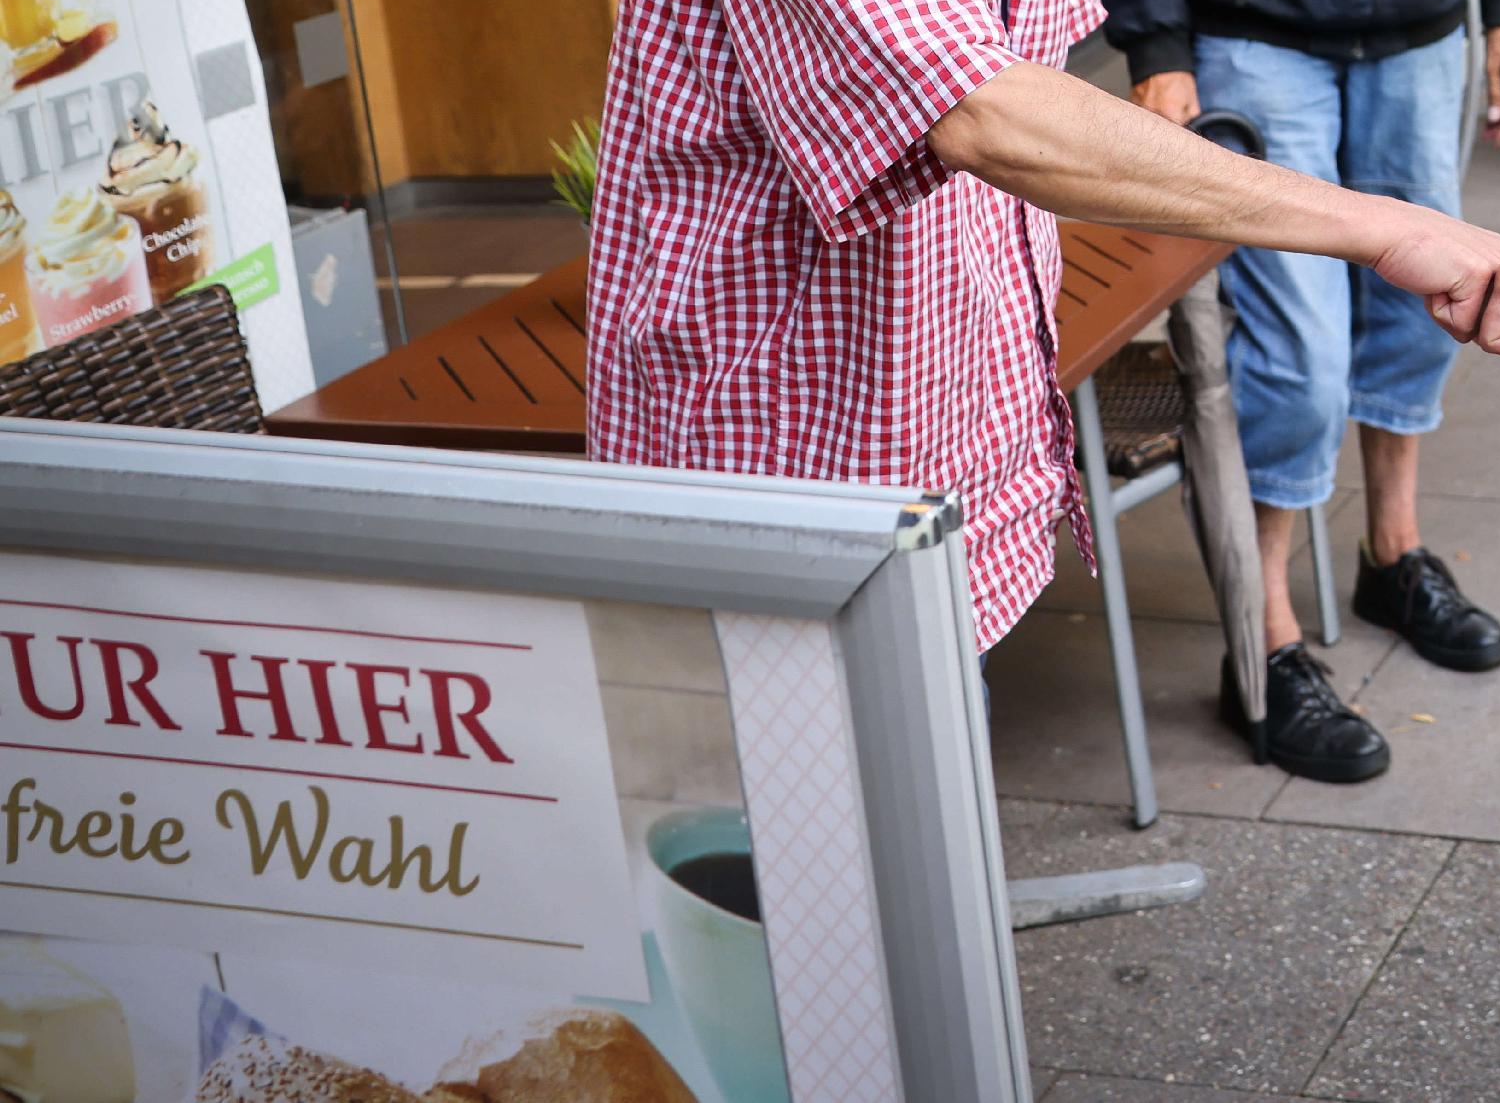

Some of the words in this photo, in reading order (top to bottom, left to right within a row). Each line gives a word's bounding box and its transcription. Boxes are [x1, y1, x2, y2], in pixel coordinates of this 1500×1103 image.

[0, 71, 156, 186] IER
[49, 294, 134, 340] Strawberry
[0, 630, 182, 730] UR
[199, 649, 514, 764] HIER
[1, 777, 190, 864] freie
[216, 785, 480, 897] Wahl
